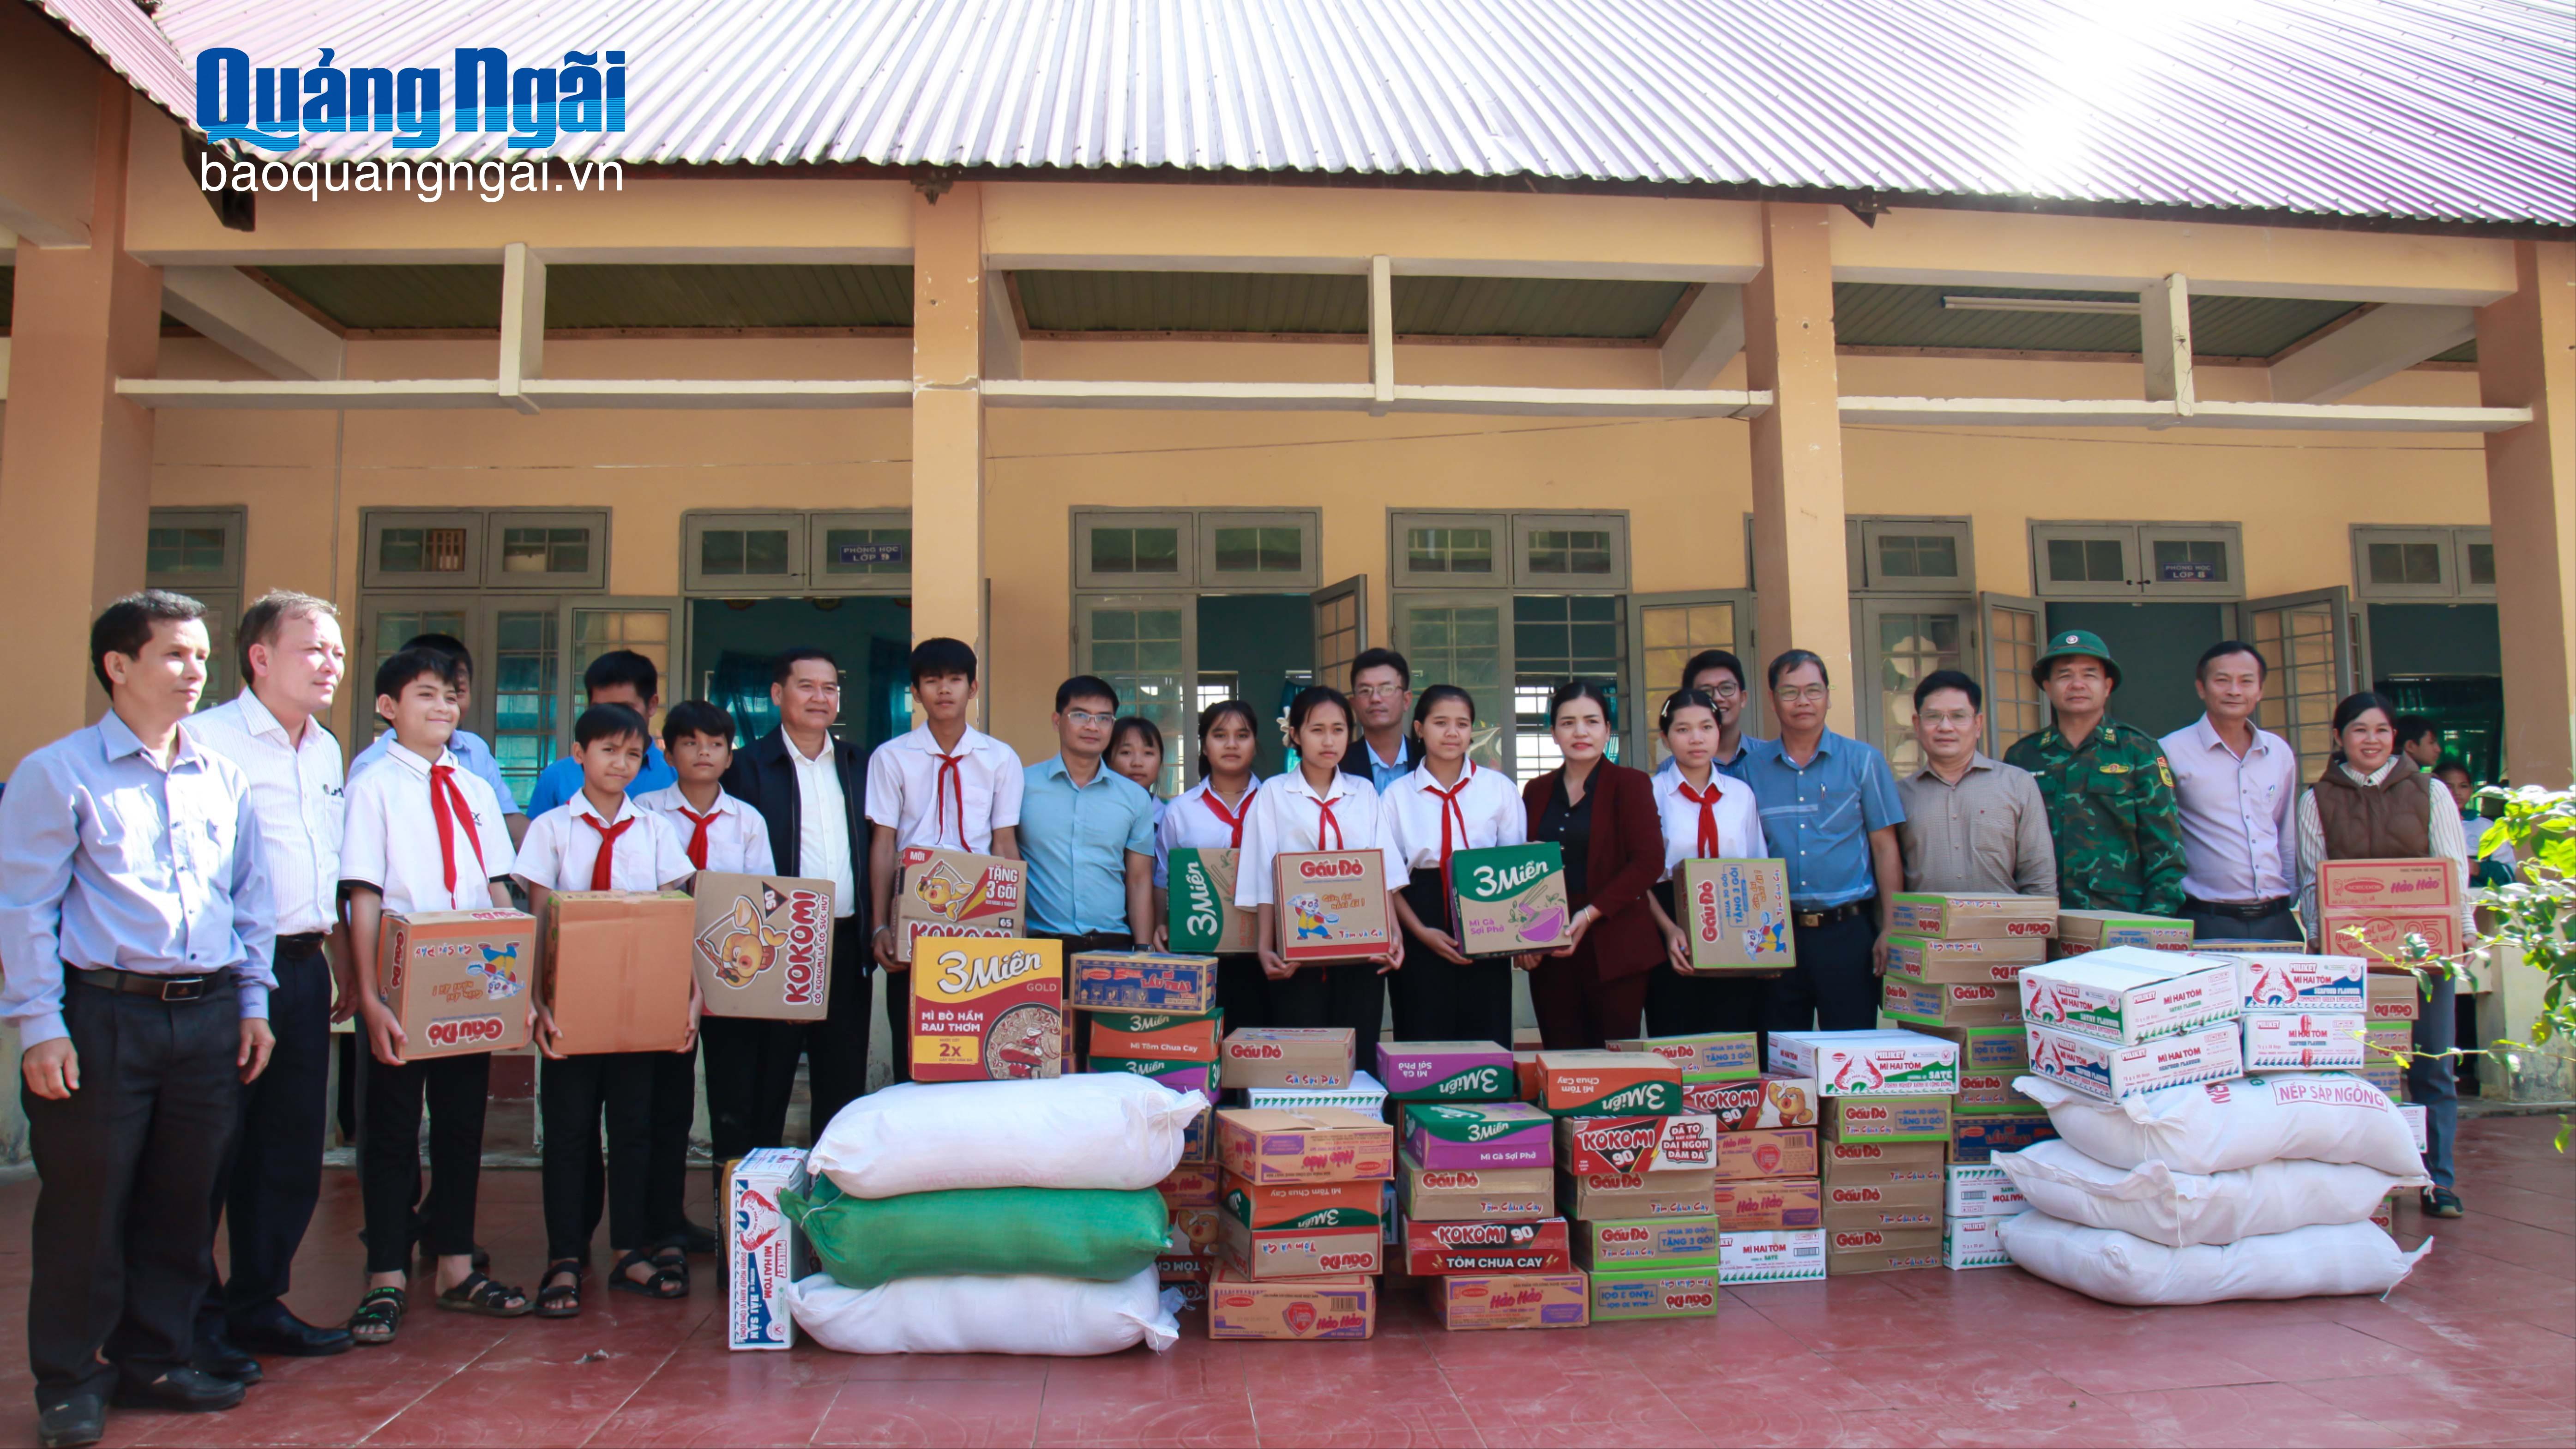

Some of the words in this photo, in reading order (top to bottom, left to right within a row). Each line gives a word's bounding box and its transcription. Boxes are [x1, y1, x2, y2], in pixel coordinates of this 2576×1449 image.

[910, 851, 925, 861] MỚI
[988, 864, 1018, 883] TẶNG
[1300, 859, 1337, 877] Gấu
[1339, 858, 1364, 876] Đỏ
[1474, 865, 1497, 897] 3
[1496, 860, 1549, 894] Miền
[2391, 880, 2413, 894] Hảo
[2415, 876, 2439, 890] Hảo
[986, 881, 995, 899] 3
[997, 884, 1017, 900] GÓI
[1185, 862, 1216, 916] Miền
[764, 890, 776, 910] 90
[1000, 918, 1012, 927] 65
[1187, 914, 1217, 936] 3
[785, 892, 817, 1002] KOKOMI
[938, 951, 969, 993] 3
[969, 950, 1042, 991] Miền
[1026, 983, 1057, 993] GOLD
[2163, 996, 2172, 1005] MÌ
[2173, 992, 2185, 1003] HAI
[2186, 988, 2202, 999] TÔM
[921, 1010, 934, 1020] MÌ
[938, 1010, 954, 1021] BÒ
[1130, 1015, 1141, 1031] 3
[921, 1023, 945, 1032] RAU
[948, 1022, 981, 1032] THƠM
[939, 1043, 961, 1057] 2x
[1183, 1044, 1198, 1053] Cay
[1231, 1044, 1261, 1059] Gấu
[1262, 1043, 1282, 1059] Đỏ
[2157, 1053, 2167, 1063] MÌ
[2168, 1050, 2182, 1061] HAI
[2183, 1047, 2201, 1057] TÔM
[1402, 1070, 1414, 1078] Gà
[1417, 1069, 1427, 1078] Mì
[1439, 1069, 1482, 1094] Miền
[1481, 1068, 1498, 1093] 3
[1557, 1076, 1573, 1085] Cay
[1561, 1085, 1581, 1093] Tôm
[1583, 1085, 1594, 1093] Mì
[1647, 1083, 1665, 1109] 3
[2280, 1082, 2307, 1101] NẾP
[2310, 1085, 2332, 1101] SÁP
[1602, 1084, 1649, 1111] Miền
[1696, 1089, 1759, 1109] KOKOMI
[1722, 1111, 1742, 1124] 90
[1468, 1124, 1481, 1142] 3
[1480, 1122, 1509, 1141] Miền
[1686, 1124, 1700, 1133] TO
[1582, 1129, 1655, 1151] KOKOMI
[1681, 1140, 1709, 1148] NGON
[1481, 1153, 1491, 1161] Mì
[1493, 1152, 1504, 1161] Gà
[1505, 1152, 1518, 1161] Sợi
[1612, 1151, 1635, 1166] 90
[1422, 1172, 1456, 1188] Gấu
[1456, 1171, 1479, 1187] Đỏ
[1589, 1174, 1621, 1189] Gấu
[1621, 1173, 1643, 1189] Đỏ
[1270, 1189, 1286, 1198] Cay
[1288, 1188, 1309, 1196] Chua
[1325, 1208, 1339, 1226] 3
[1438, 1226, 1506, 1244] KOKOMI
[1510, 1226, 1534, 1243] 90
[1662, 1237, 1687, 1247] TẶNG
[764, 1246, 773, 1258] MÌ
[1743, 1245, 1752, 1254] MÌ
[1754, 1245, 1767, 1253] HAI
[1769, 1244, 1786, 1252] TÔM
[764, 1259, 772, 1276] HAI
[1446, 1256, 1476, 1268] TÔM
[1478, 1257, 1514, 1268] CHUA
[1517, 1257, 1543, 1268] CAY
[764, 1277, 773, 1300] TÔM
[750, 1294, 763, 1314] HẢI
[748, 1316, 762, 1339] SẢN
